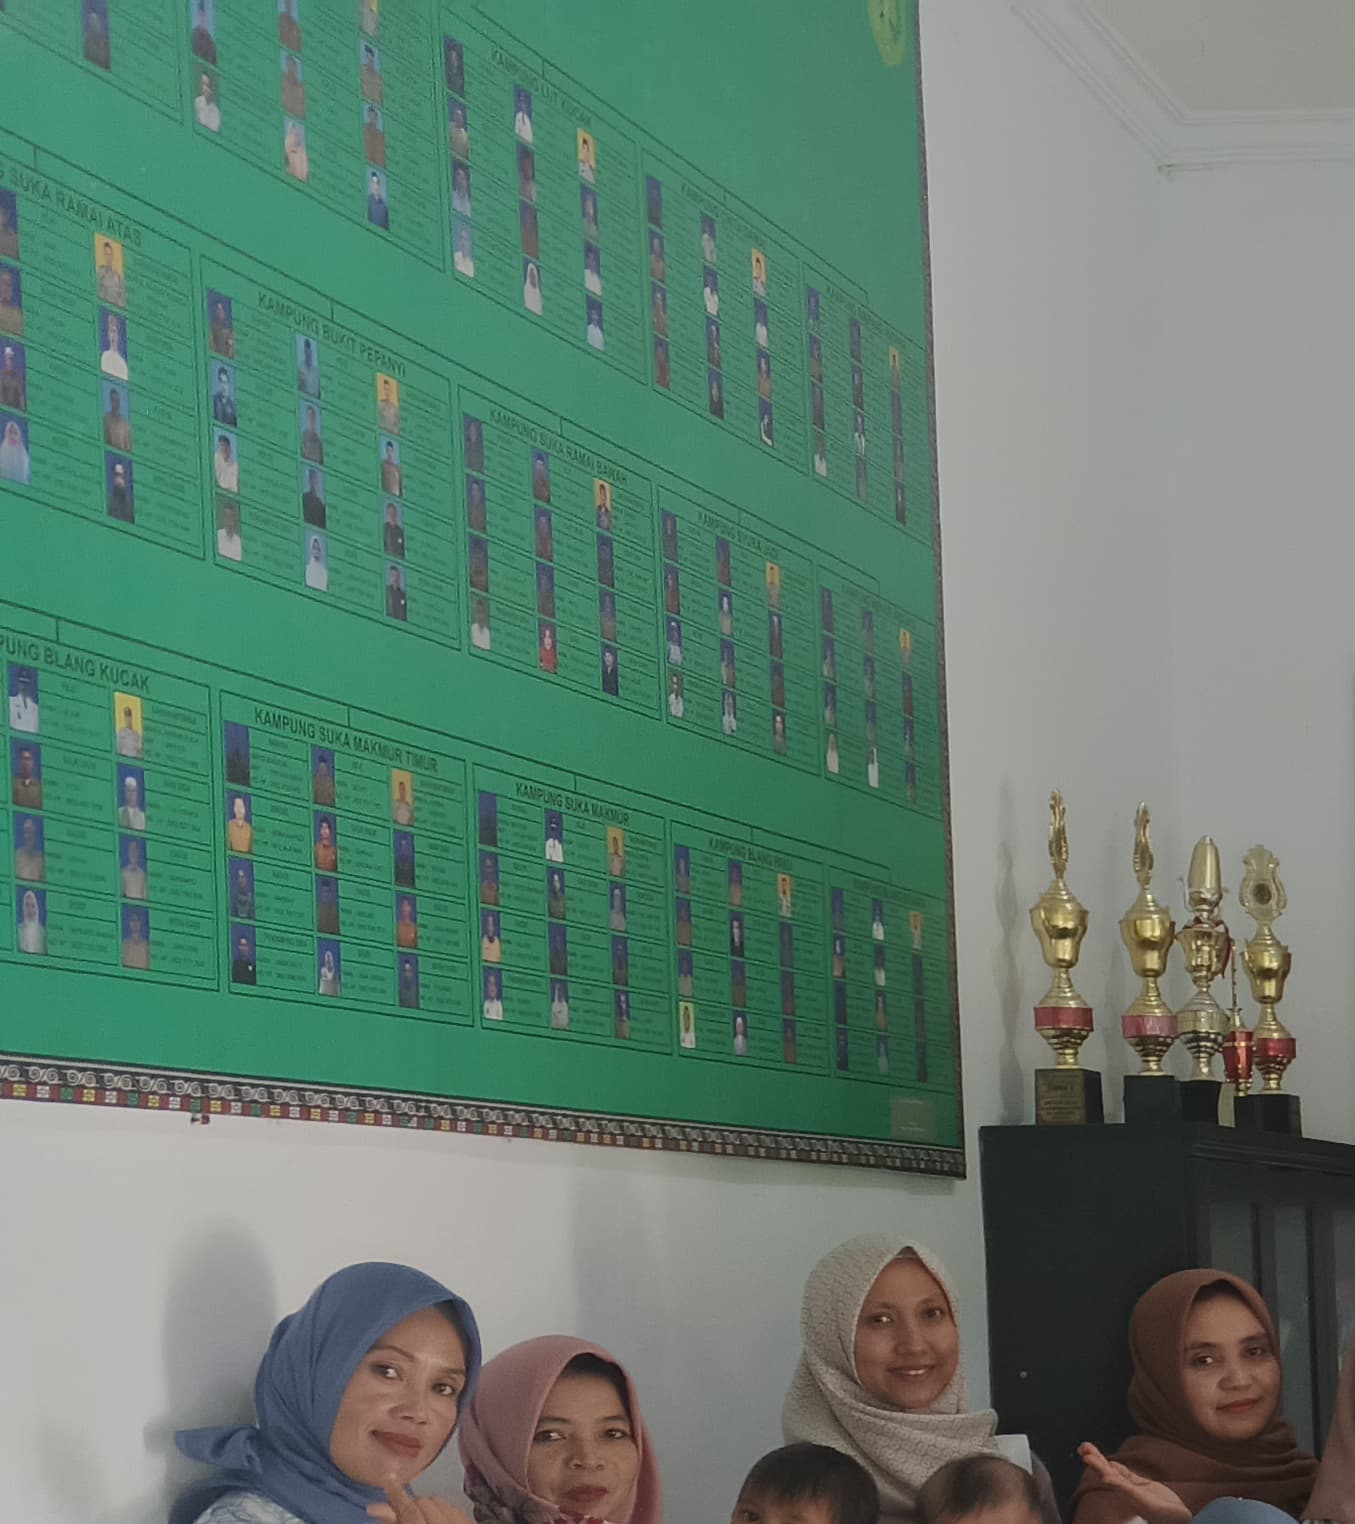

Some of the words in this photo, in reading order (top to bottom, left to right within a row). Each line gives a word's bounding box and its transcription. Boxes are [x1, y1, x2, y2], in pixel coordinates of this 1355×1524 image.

[258, 291, 320, 335] KAMPUNG
[43, 647, 96, 677] BLANG
[99, 662, 150, 692] KUCAK
[254, 706, 316, 740] KAMPUNG
[317, 726, 351, 749] SUKA
[351, 735, 403, 763] MAKMUR
[404, 749, 439, 774] TIMUR
[515, 781, 563, 809] KAMPUNG
[564, 795, 590, 816] SUKA
